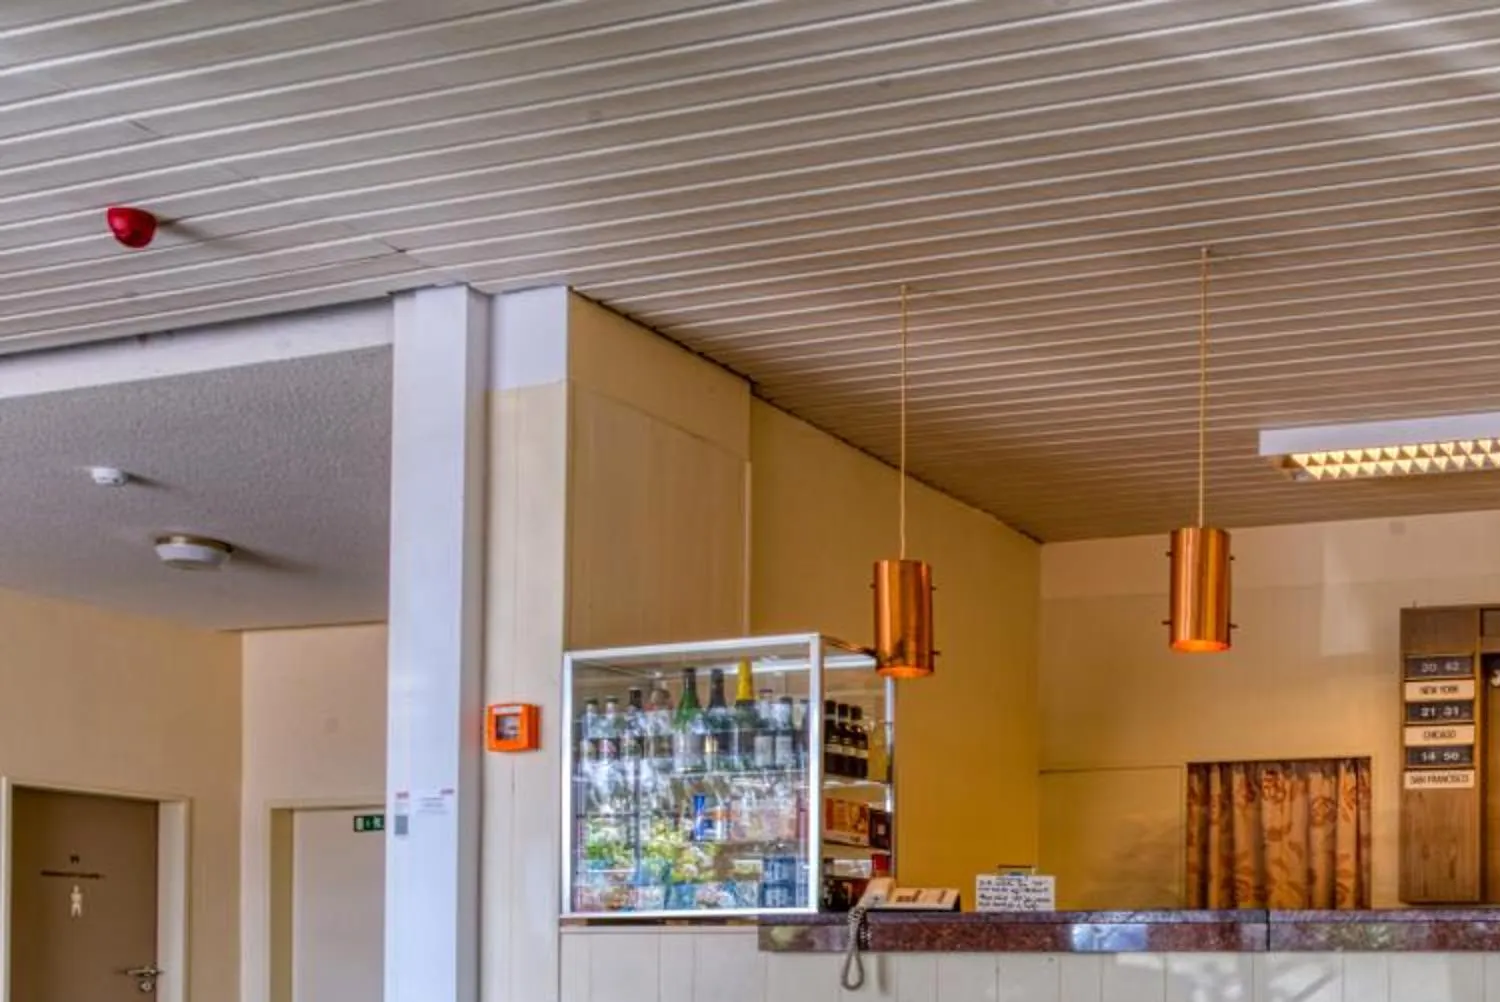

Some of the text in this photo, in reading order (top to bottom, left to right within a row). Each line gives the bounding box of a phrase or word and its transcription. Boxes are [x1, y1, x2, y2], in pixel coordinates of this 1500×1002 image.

[1420, 684, 1459, 695] NEW YORK
[1423, 729, 1457, 739] CHICAGO
[1410, 774, 1469, 785] SAN FRANCISCO
